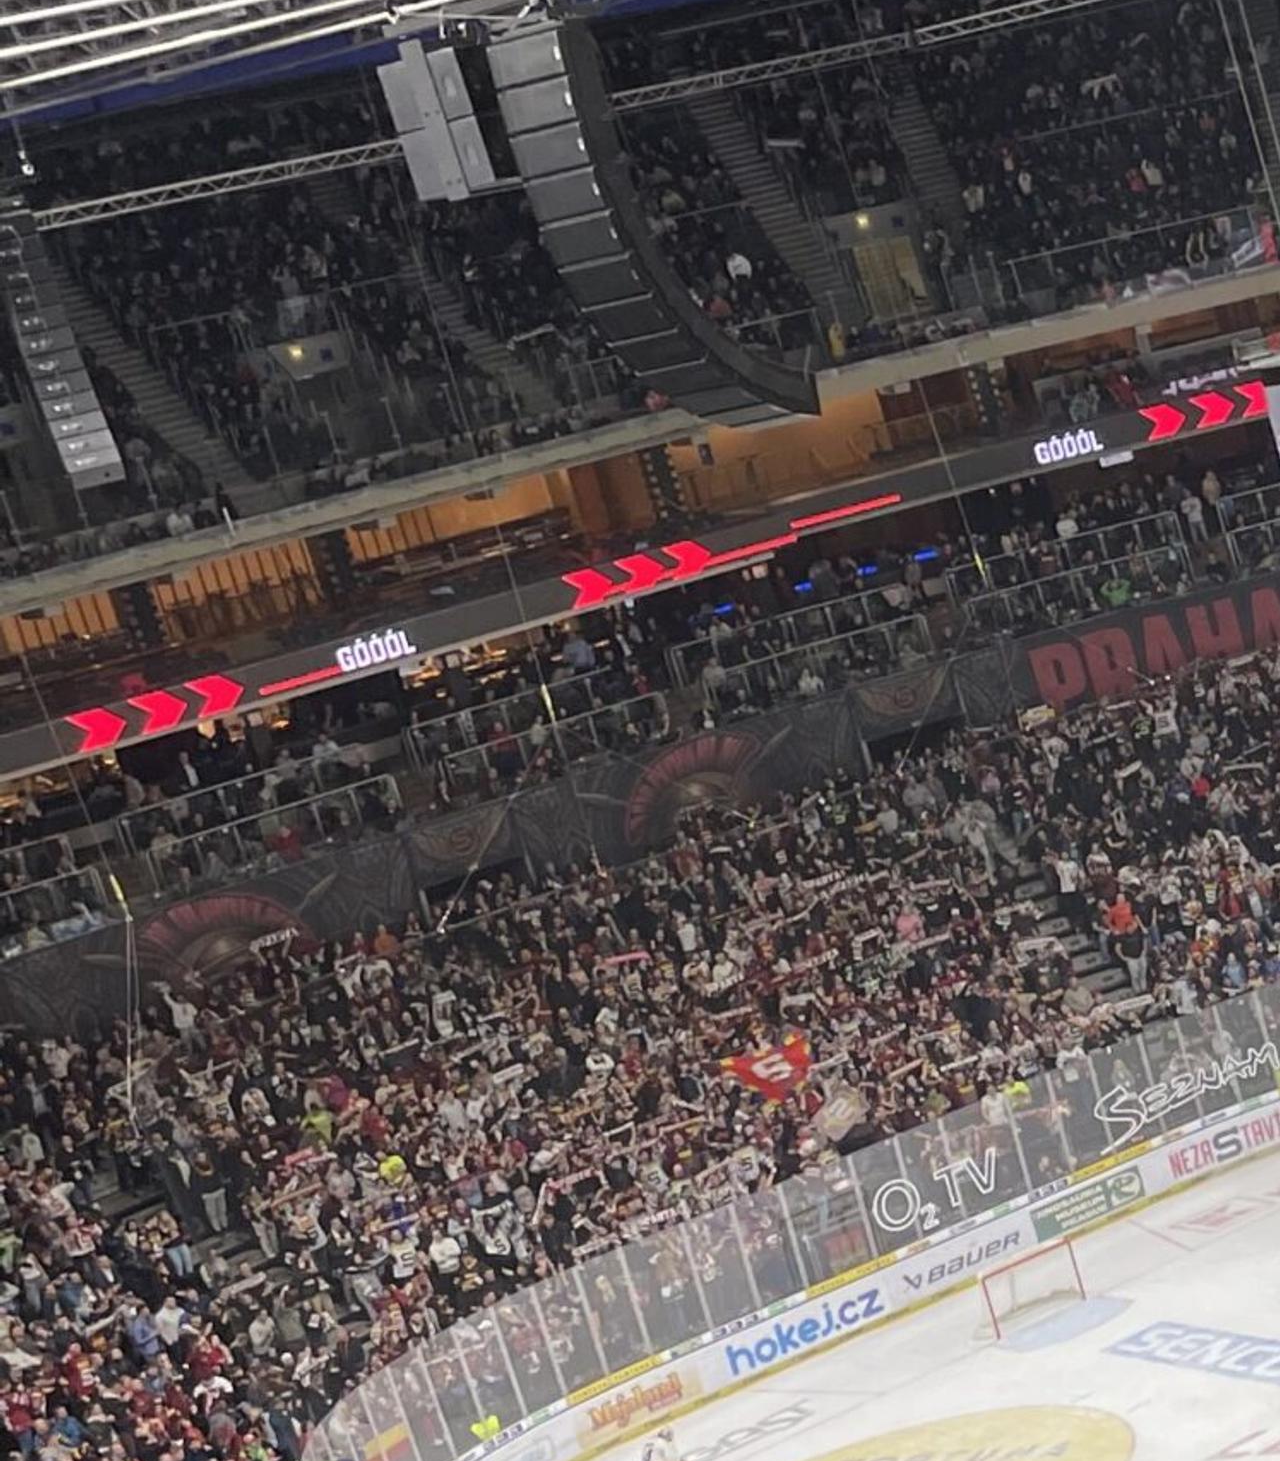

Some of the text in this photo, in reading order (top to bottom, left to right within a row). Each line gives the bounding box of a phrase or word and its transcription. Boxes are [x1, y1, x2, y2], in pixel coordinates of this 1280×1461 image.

[1033, 429, 1103, 465] GÓÓÓL
[335, 630, 417, 672] GÓÓÓL
[933, 1148, 997, 1210] TV
[725, 1287, 886, 1378] hokej.cz
